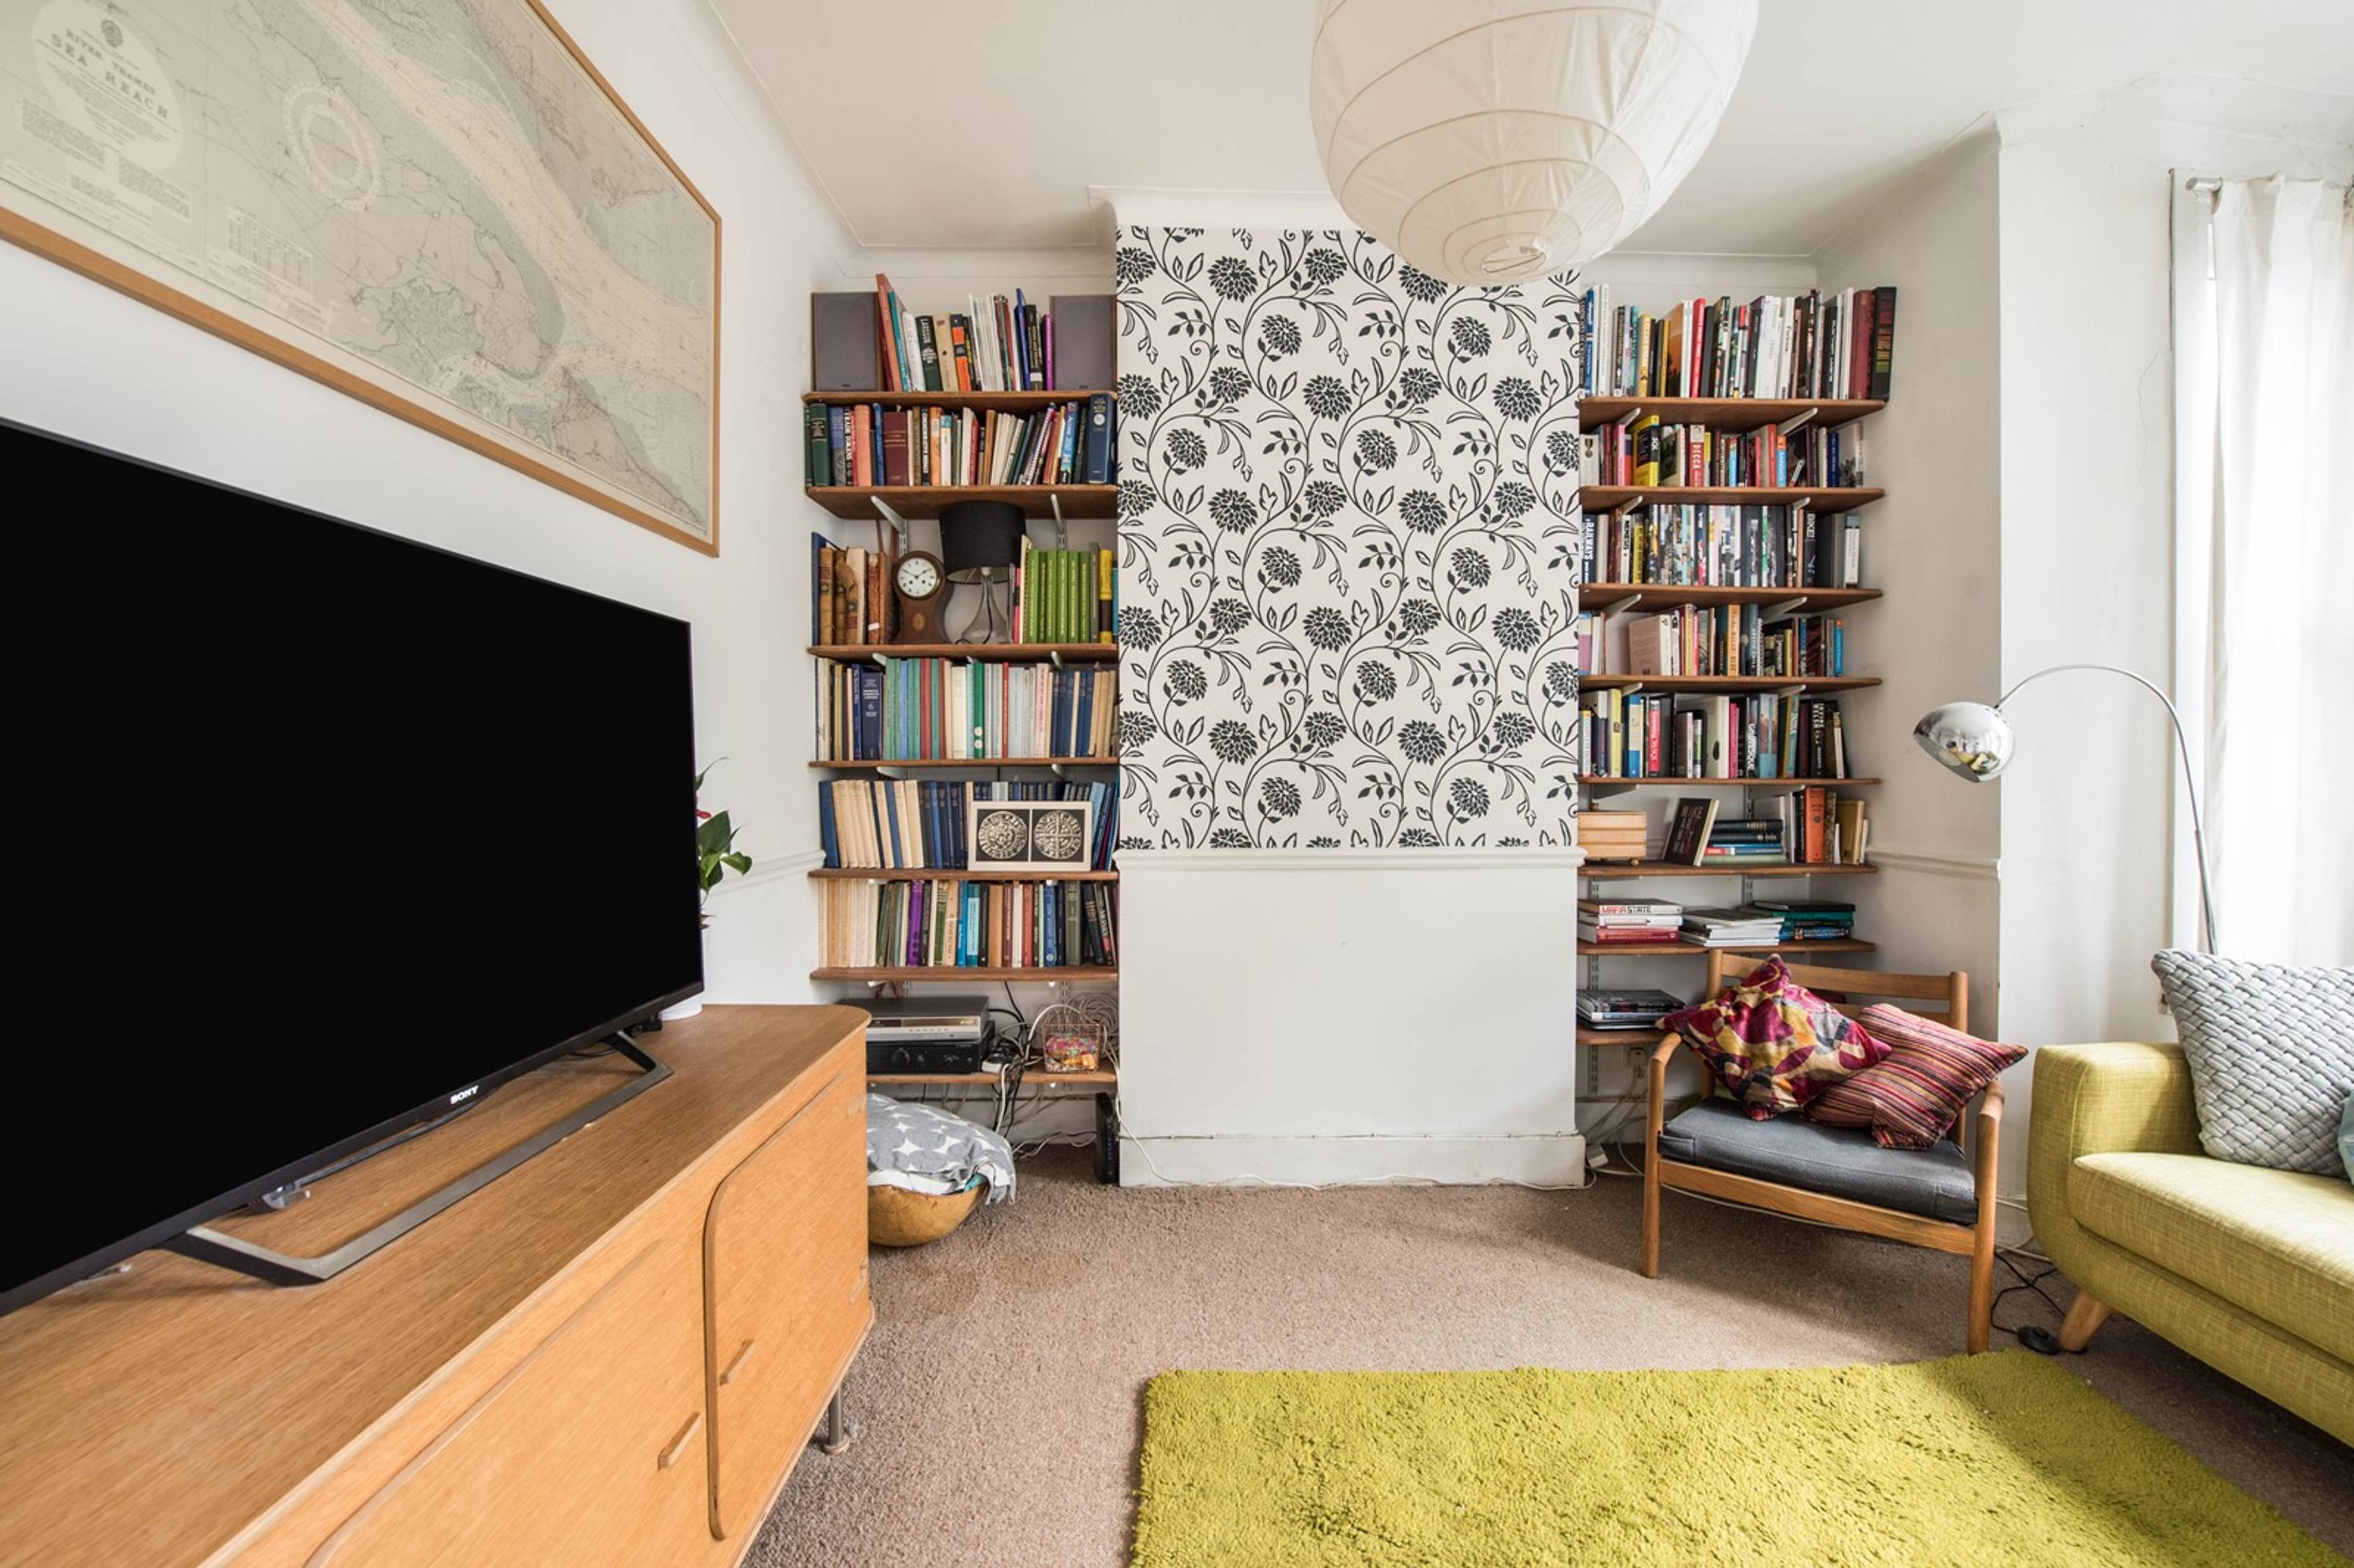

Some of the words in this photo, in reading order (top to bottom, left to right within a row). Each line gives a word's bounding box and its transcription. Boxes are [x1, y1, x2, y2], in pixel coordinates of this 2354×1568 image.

[51, 33, 88, 67] SEA
[104, 70, 169, 119] REACH
[1693, 444, 1701, 469] DECCA
[1585, 522, 1594, 560] RAILWAYS
[1747, 723, 1756, 771] GROTESQUE
[1100, 910, 1108, 937] MONEY
[450, 1085, 479, 1105] SONY
